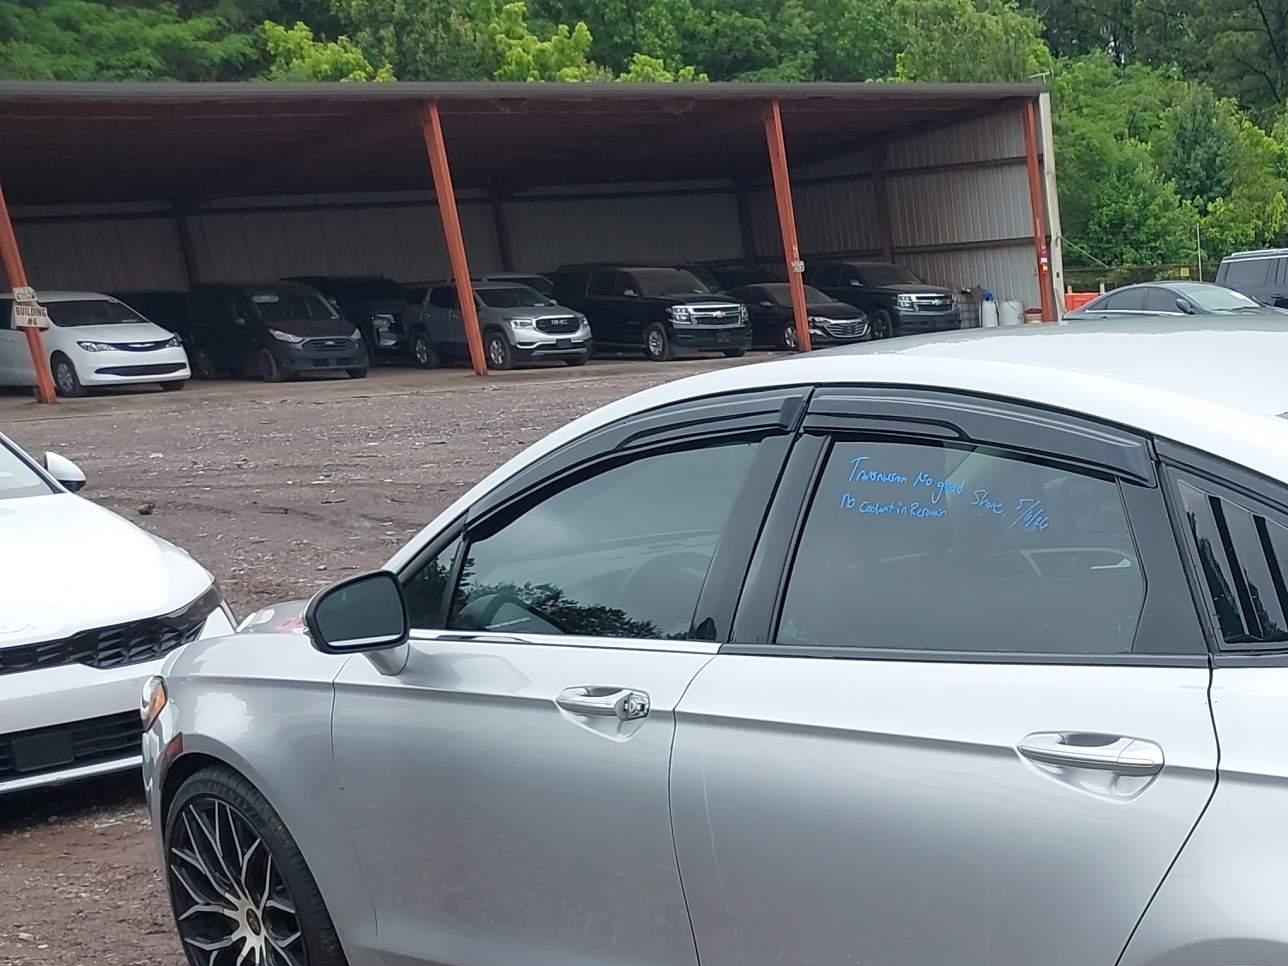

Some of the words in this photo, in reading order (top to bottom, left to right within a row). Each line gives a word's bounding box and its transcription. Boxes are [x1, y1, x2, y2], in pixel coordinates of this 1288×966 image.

[15, 306, 47, 318] BUILDING
[912, 471, 933, 487] No
[931, 480, 966, 504] good
[896, 502, 907, 515] in
